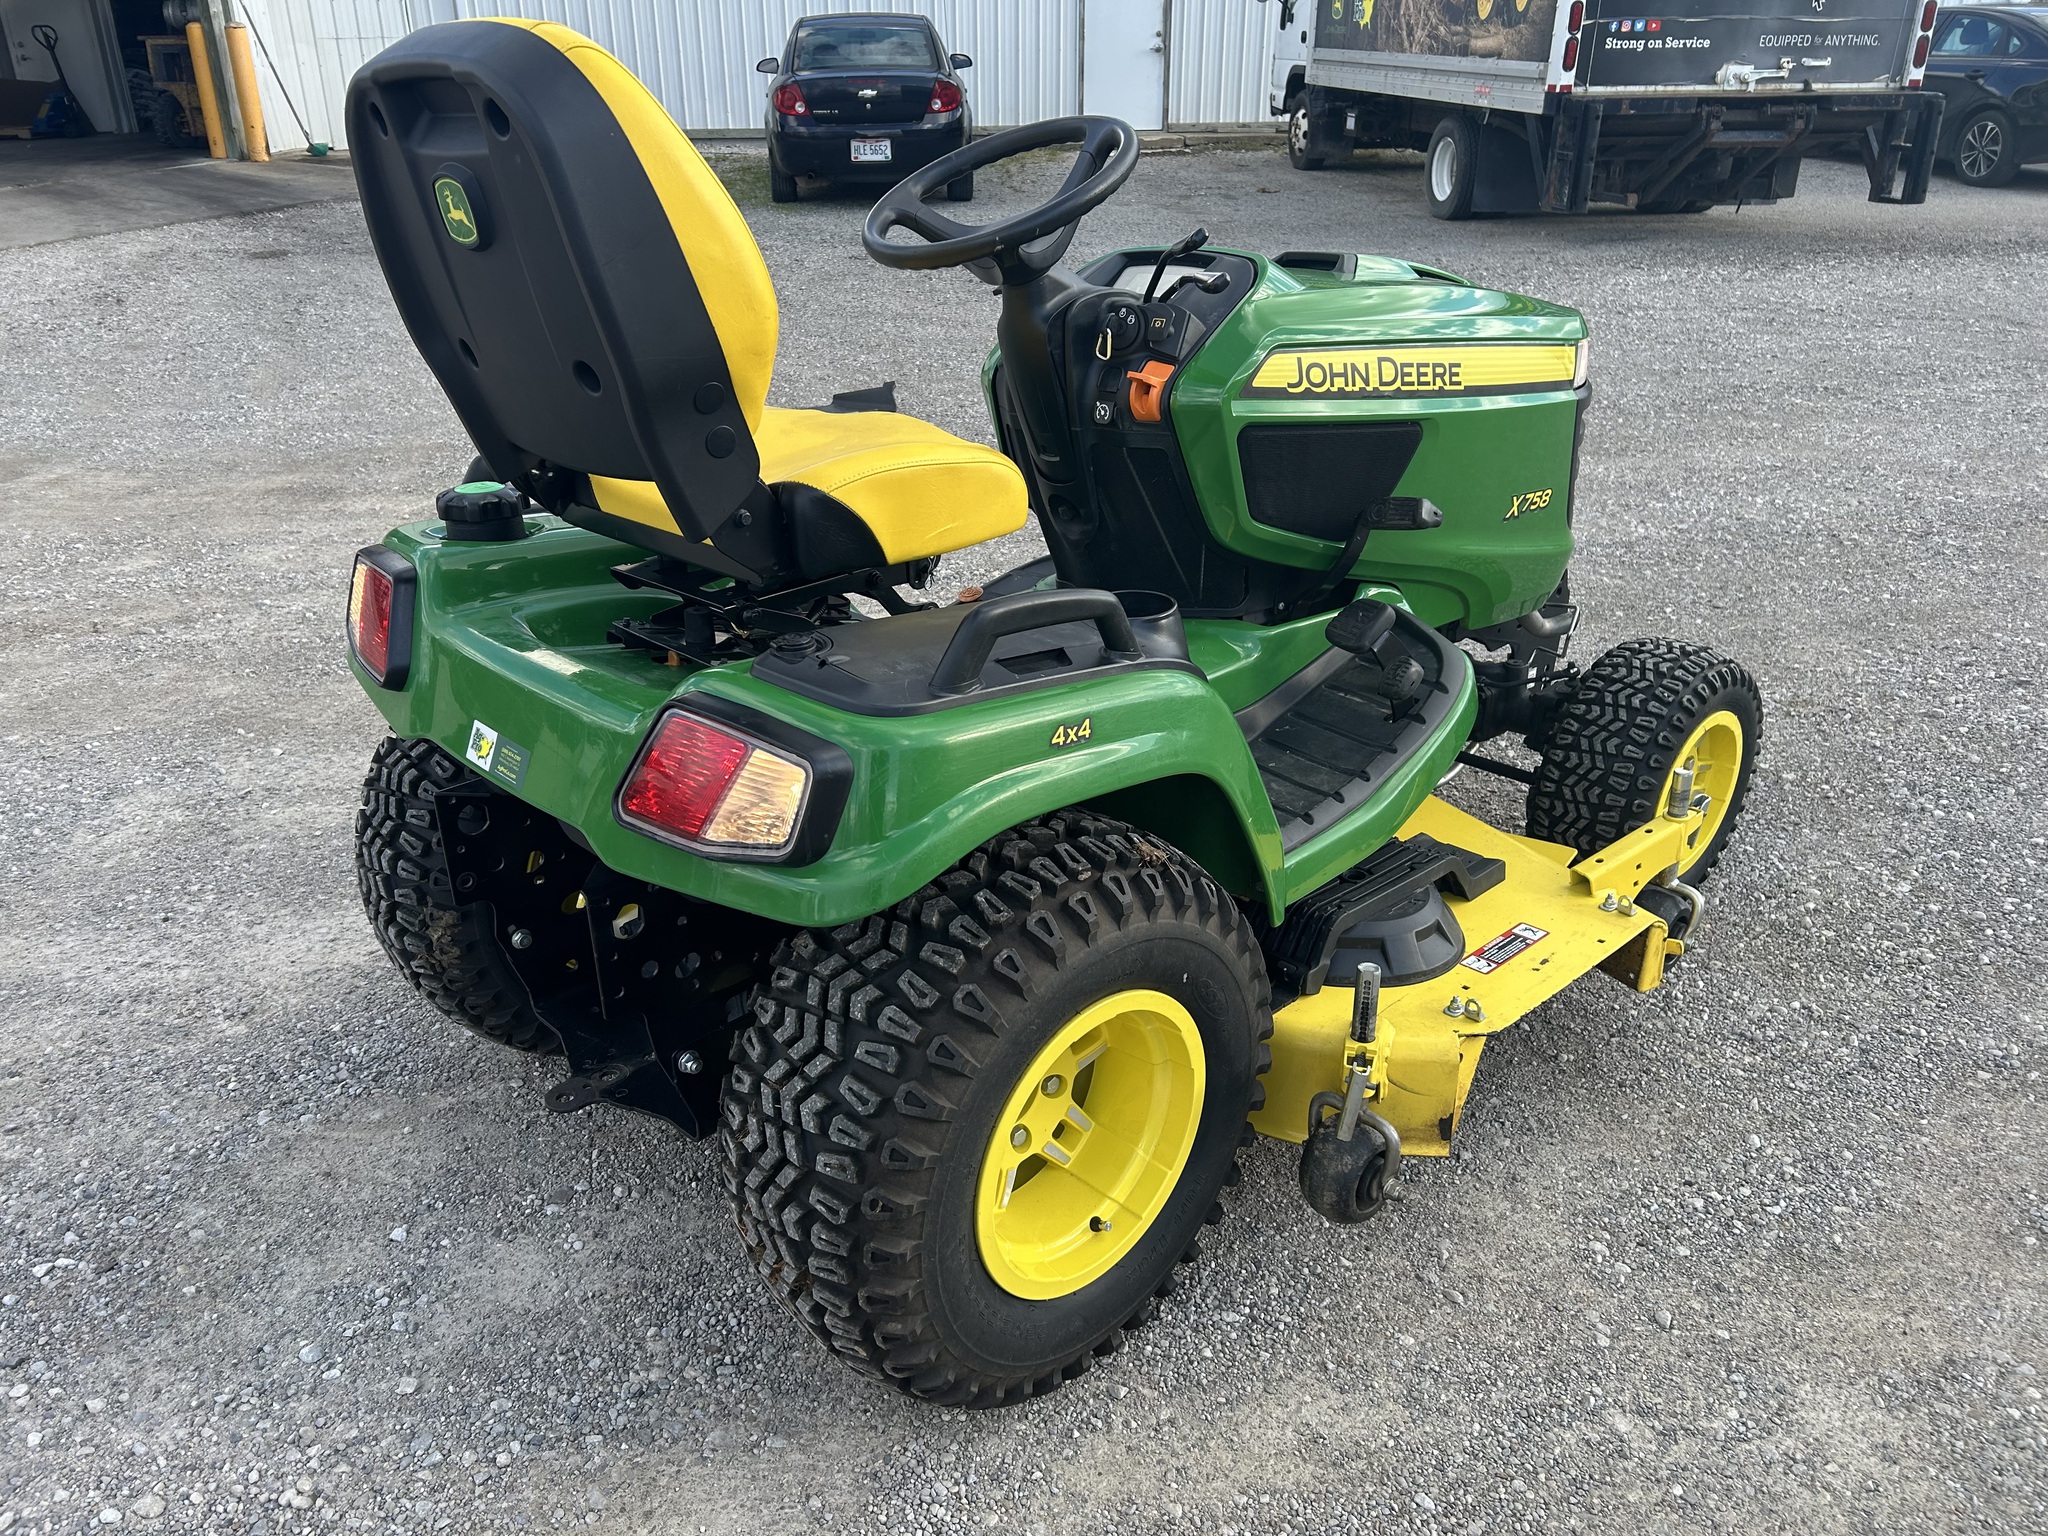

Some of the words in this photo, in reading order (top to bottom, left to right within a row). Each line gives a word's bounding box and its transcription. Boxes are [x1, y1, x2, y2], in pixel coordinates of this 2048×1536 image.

[1605, 37, 1644, 51] Strong
[1647, 39, 1663, 49] on
[1665, 37, 1711, 49] Service
[1759, 34, 1811, 47] EQUIPPED
[1813, 35, 1824, 46] for
[1824, 34, 1881, 47] ANYTHING.
[853, 144, 868, 156] HLE
[869, 144, 888, 156] 5652
[1286, 356, 1371, 391] JOHN
[1376, 356, 1464, 391] DEERE
[1503, 488, 1553, 521] X758
[1051, 717, 1092, 746] 4x4
